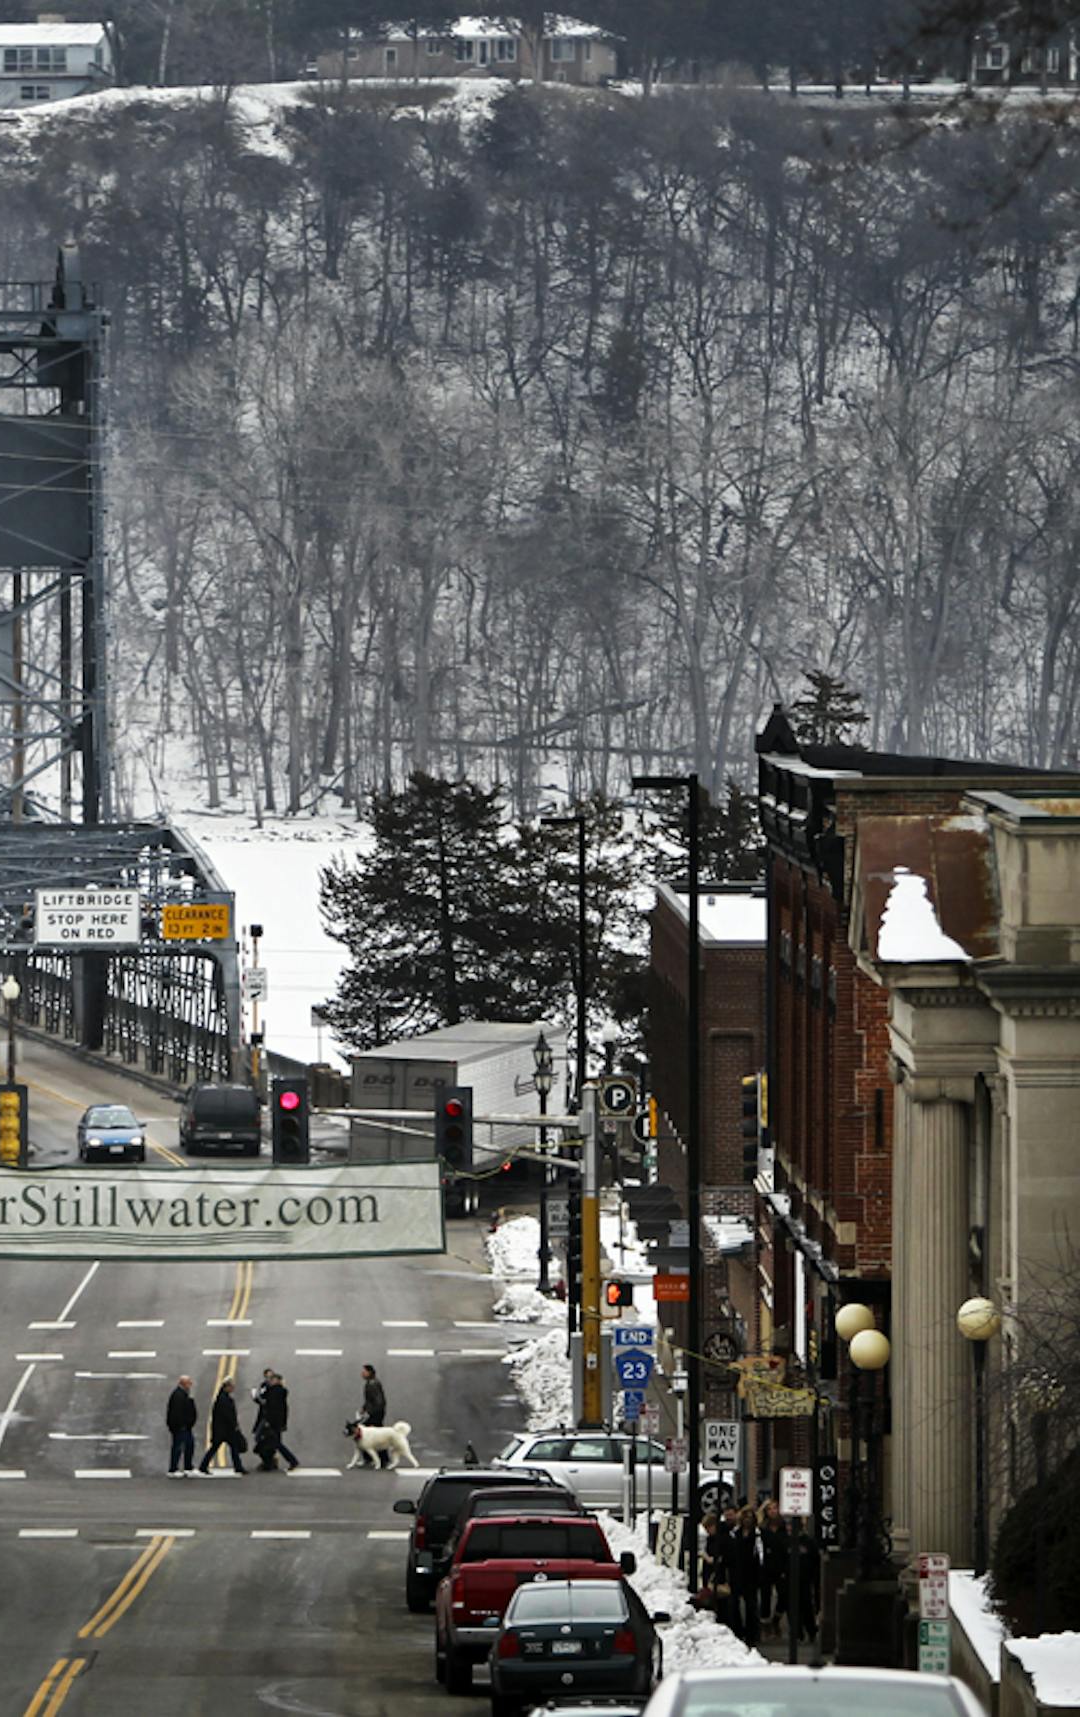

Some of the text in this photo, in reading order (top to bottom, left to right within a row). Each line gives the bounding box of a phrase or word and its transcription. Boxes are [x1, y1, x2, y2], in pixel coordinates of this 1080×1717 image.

[42, 894, 133, 906] LIFTBRIDGE
[47, 914, 128, 925] STOP HERE
[165, 909, 224, 921] CLEARANCE
[60, 927, 115, 939] ON RED
[183, 925, 194, 933] FT
[202, 924, 210, 933] 2
[611, 1089, 626, 1108] P
[620, 1330, 648, 1344] END
[622, 1362, 648, 1380] 23
[708, 1425, 737, 1437] ONE
[708, 1439, 737, 1450] WAY
